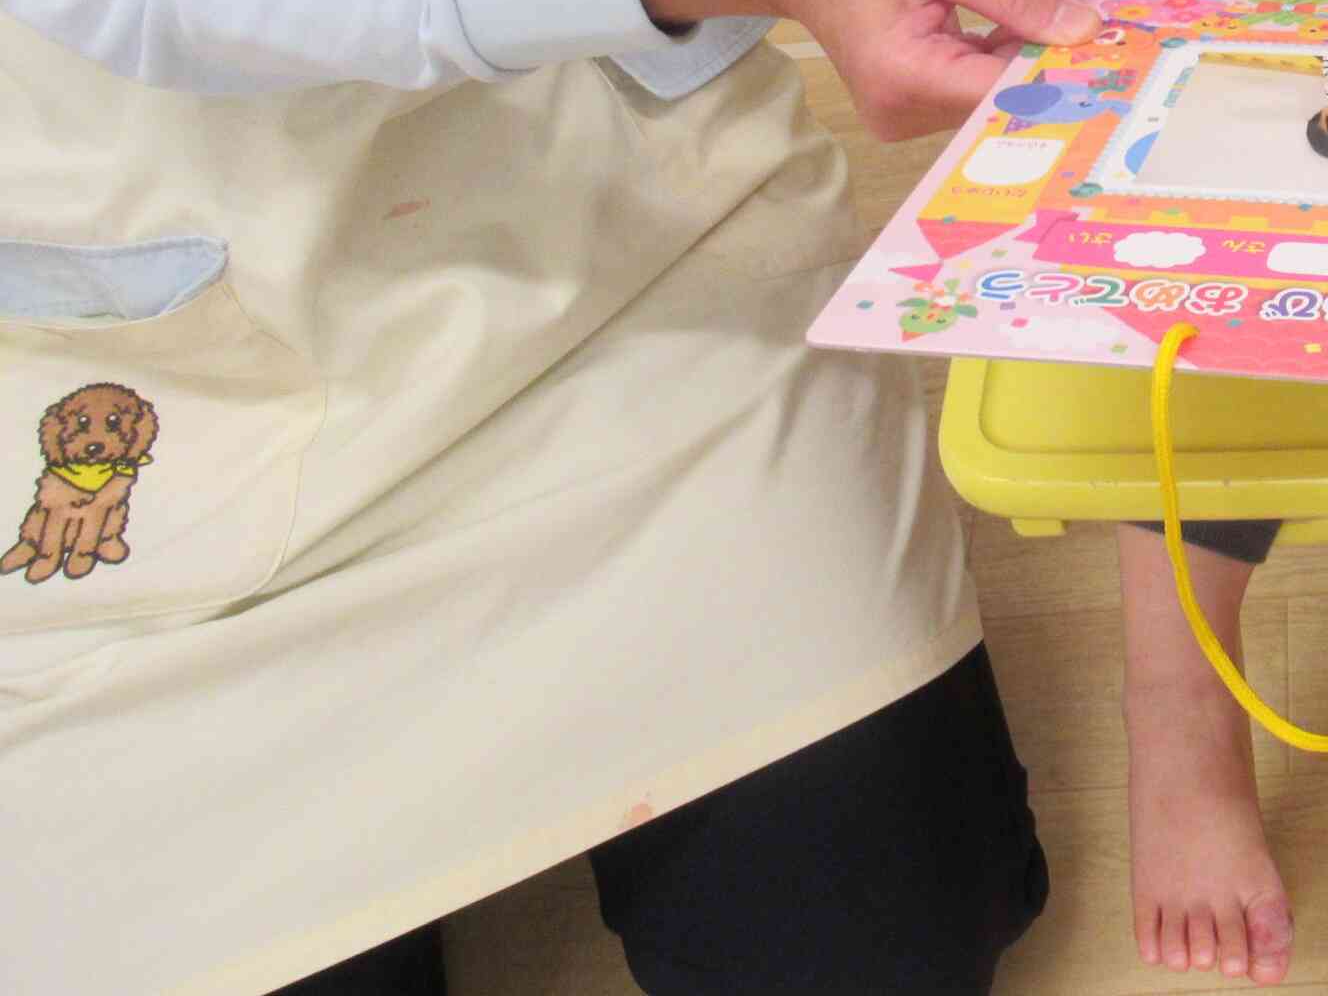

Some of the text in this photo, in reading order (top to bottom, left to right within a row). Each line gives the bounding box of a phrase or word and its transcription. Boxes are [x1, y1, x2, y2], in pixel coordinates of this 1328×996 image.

[1067, 231, 1115, 245] さい
[1222, 238, 1266, 254] さん
[978, 271, 1249, 314] おめでとう
